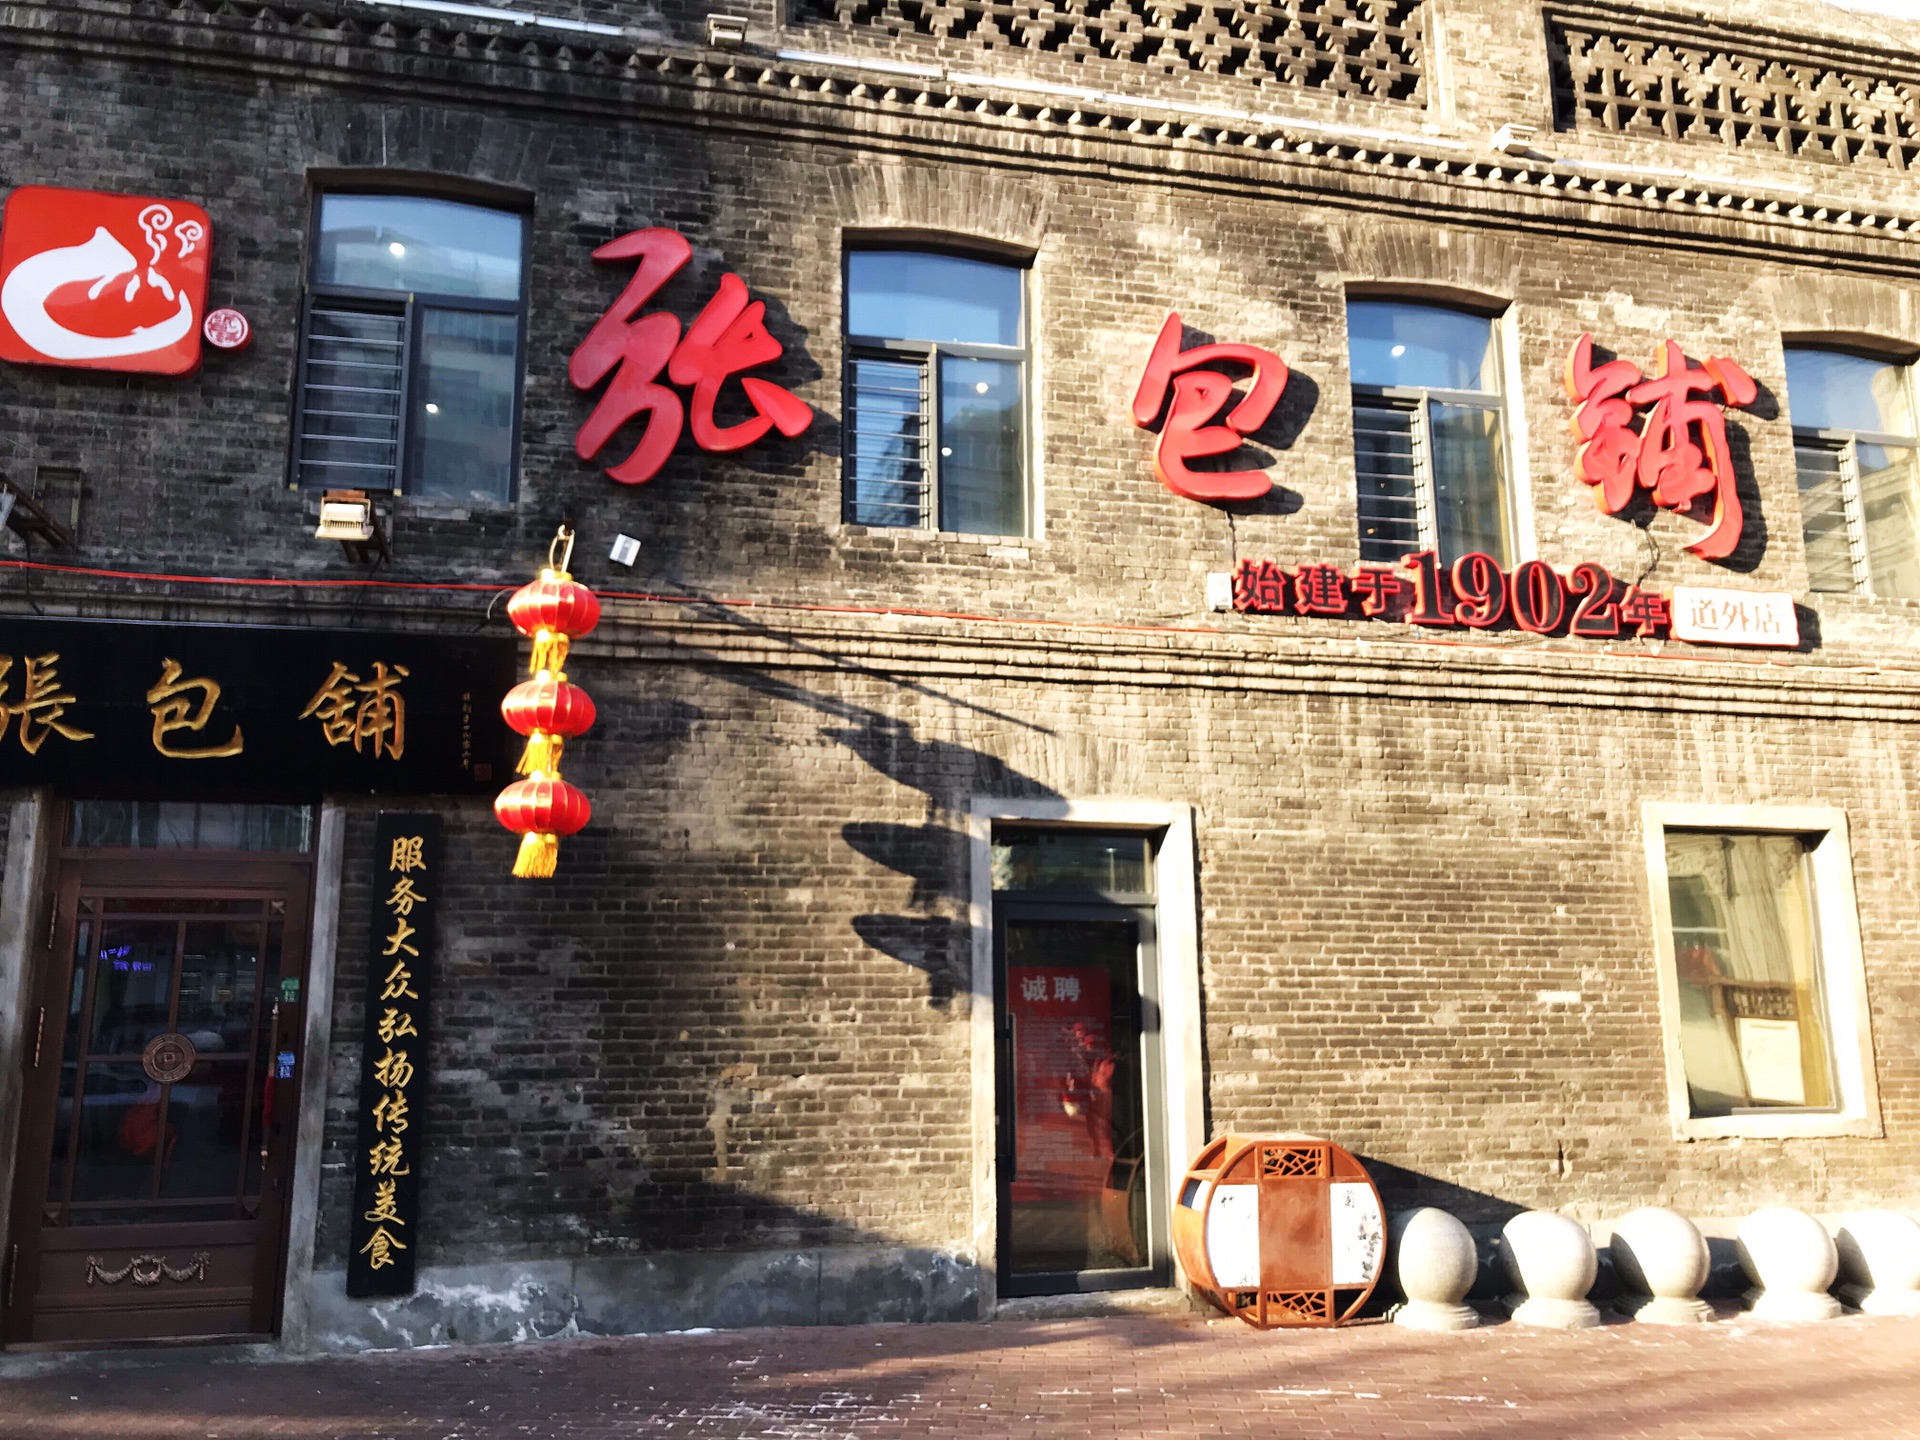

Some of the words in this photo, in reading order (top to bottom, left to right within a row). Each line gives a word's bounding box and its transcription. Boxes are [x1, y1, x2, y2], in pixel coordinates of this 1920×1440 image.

[1235, 550, 1669, 635] 始建于1902年
[1690, 598, 1782, 634] 道外店
[1021, 975, 1081, 1002] 诚聘
[358, 835, 428, 1271] 服务大众弘扬传统美食
